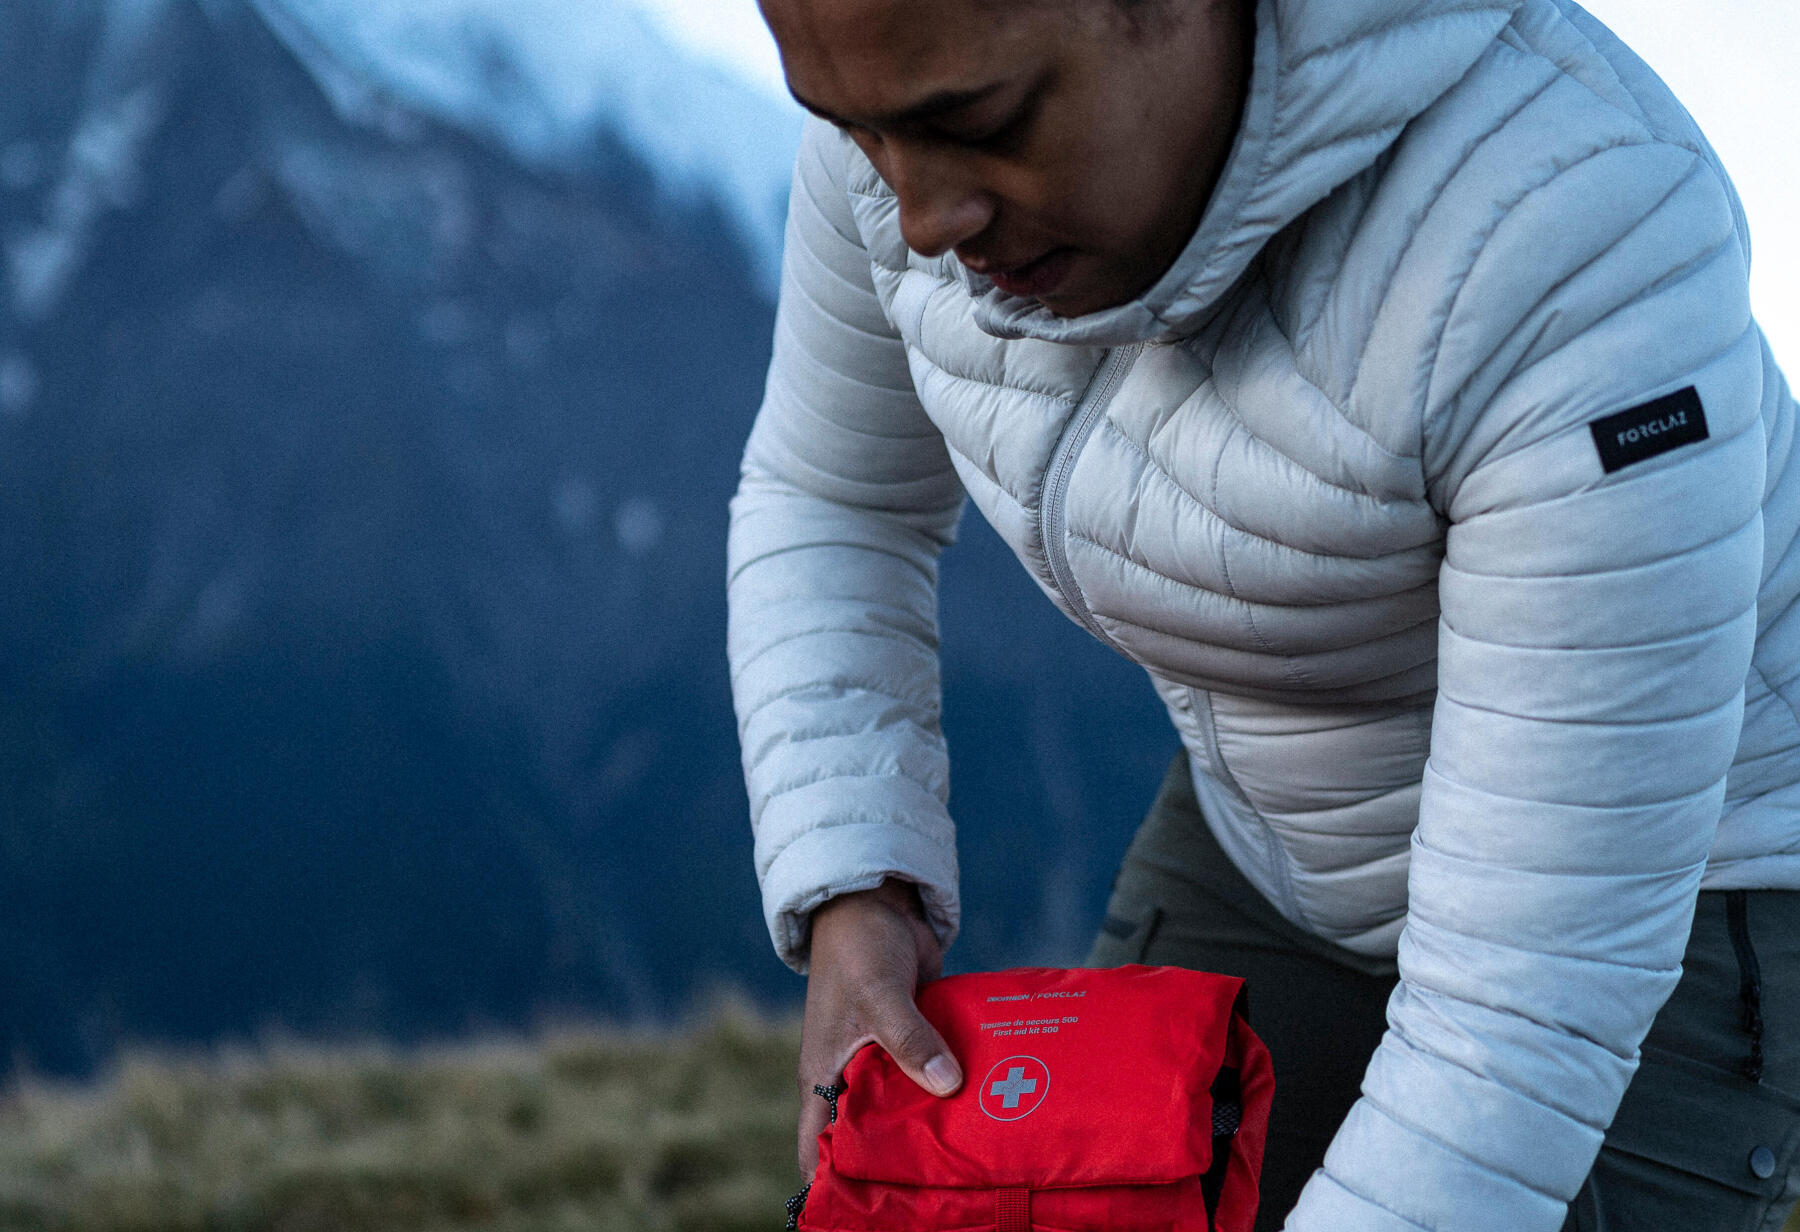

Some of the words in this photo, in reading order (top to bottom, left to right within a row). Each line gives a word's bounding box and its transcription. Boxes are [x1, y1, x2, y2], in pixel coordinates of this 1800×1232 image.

[1616, 410, 1688, 446] FORCLAZ
[1037, 991, 1087, 999] FORCLAZ
[980, 1021, 1012, 1031] Trousse
[1026, 1018, 1060, 1026] secours
[1062, 1016, 1079, 1024] 500
[993, 1029, 1012, 1037] First
[1014, 1027, 1027, 1035] aid
[1042, 1026, 1059, 1034] 500
